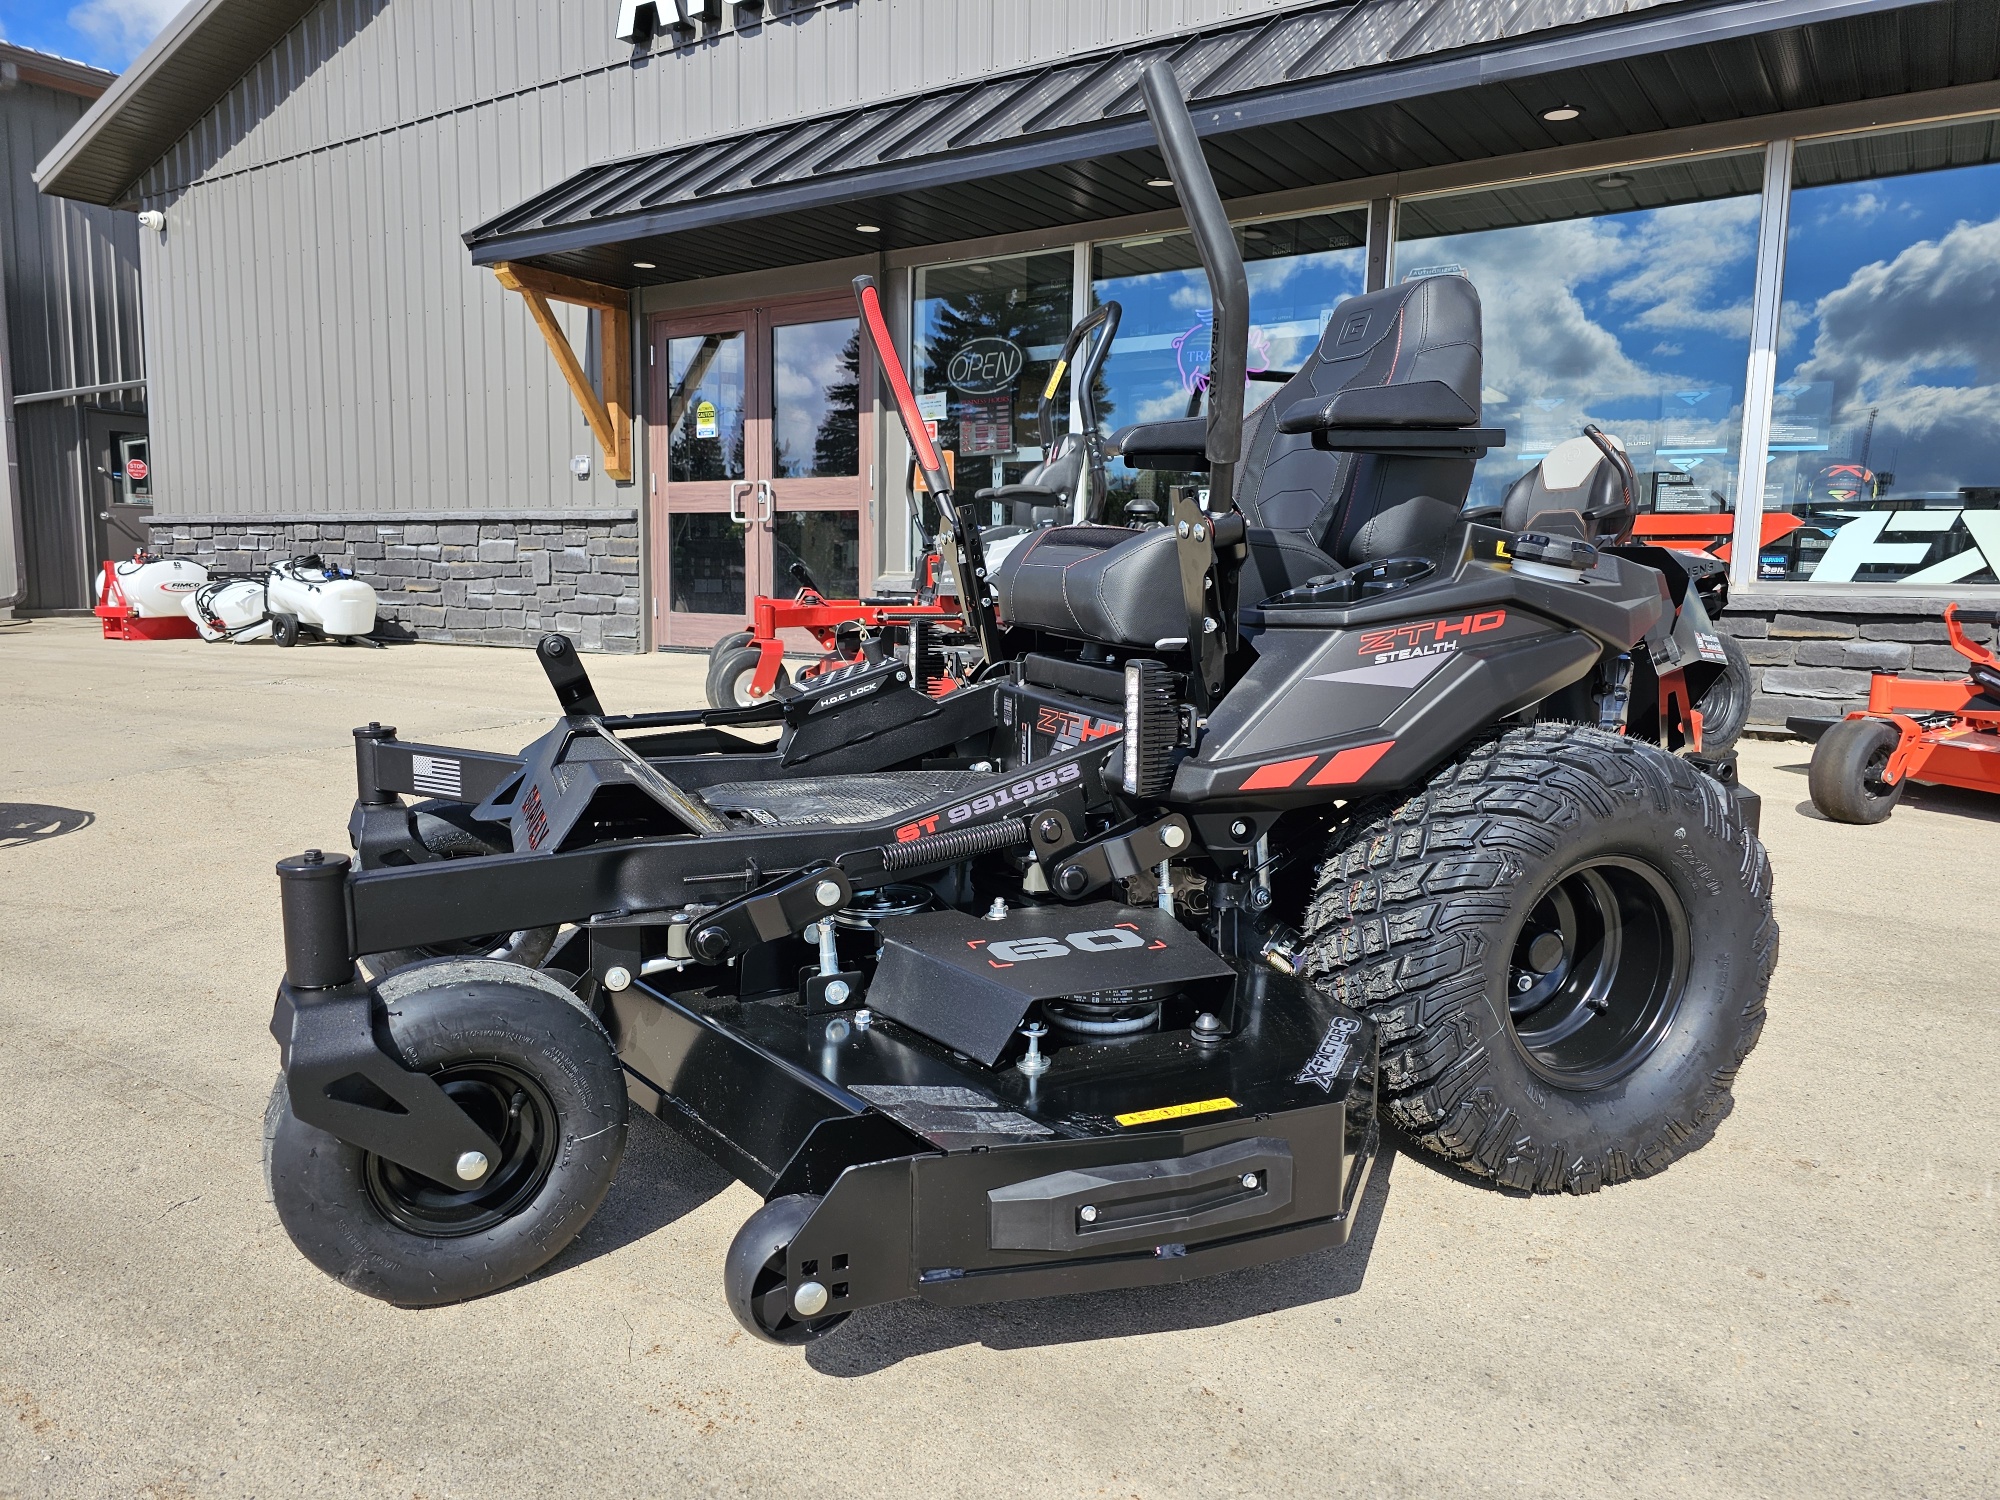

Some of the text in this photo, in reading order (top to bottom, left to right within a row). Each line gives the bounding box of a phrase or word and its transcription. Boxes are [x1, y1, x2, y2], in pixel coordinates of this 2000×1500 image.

[1413, 266, 1458, 275] AUTHORIZED
[951, 350, 1014, 381] OPEN
[1209, 317, 1220, 406] GRAVELY
[850, 682, 876, 697] LOCK
[522, 784, 550, 851] GRAVELY
[896, 763, 1080, 843] ST 991983
[986, 928, 1146, 962] 60
